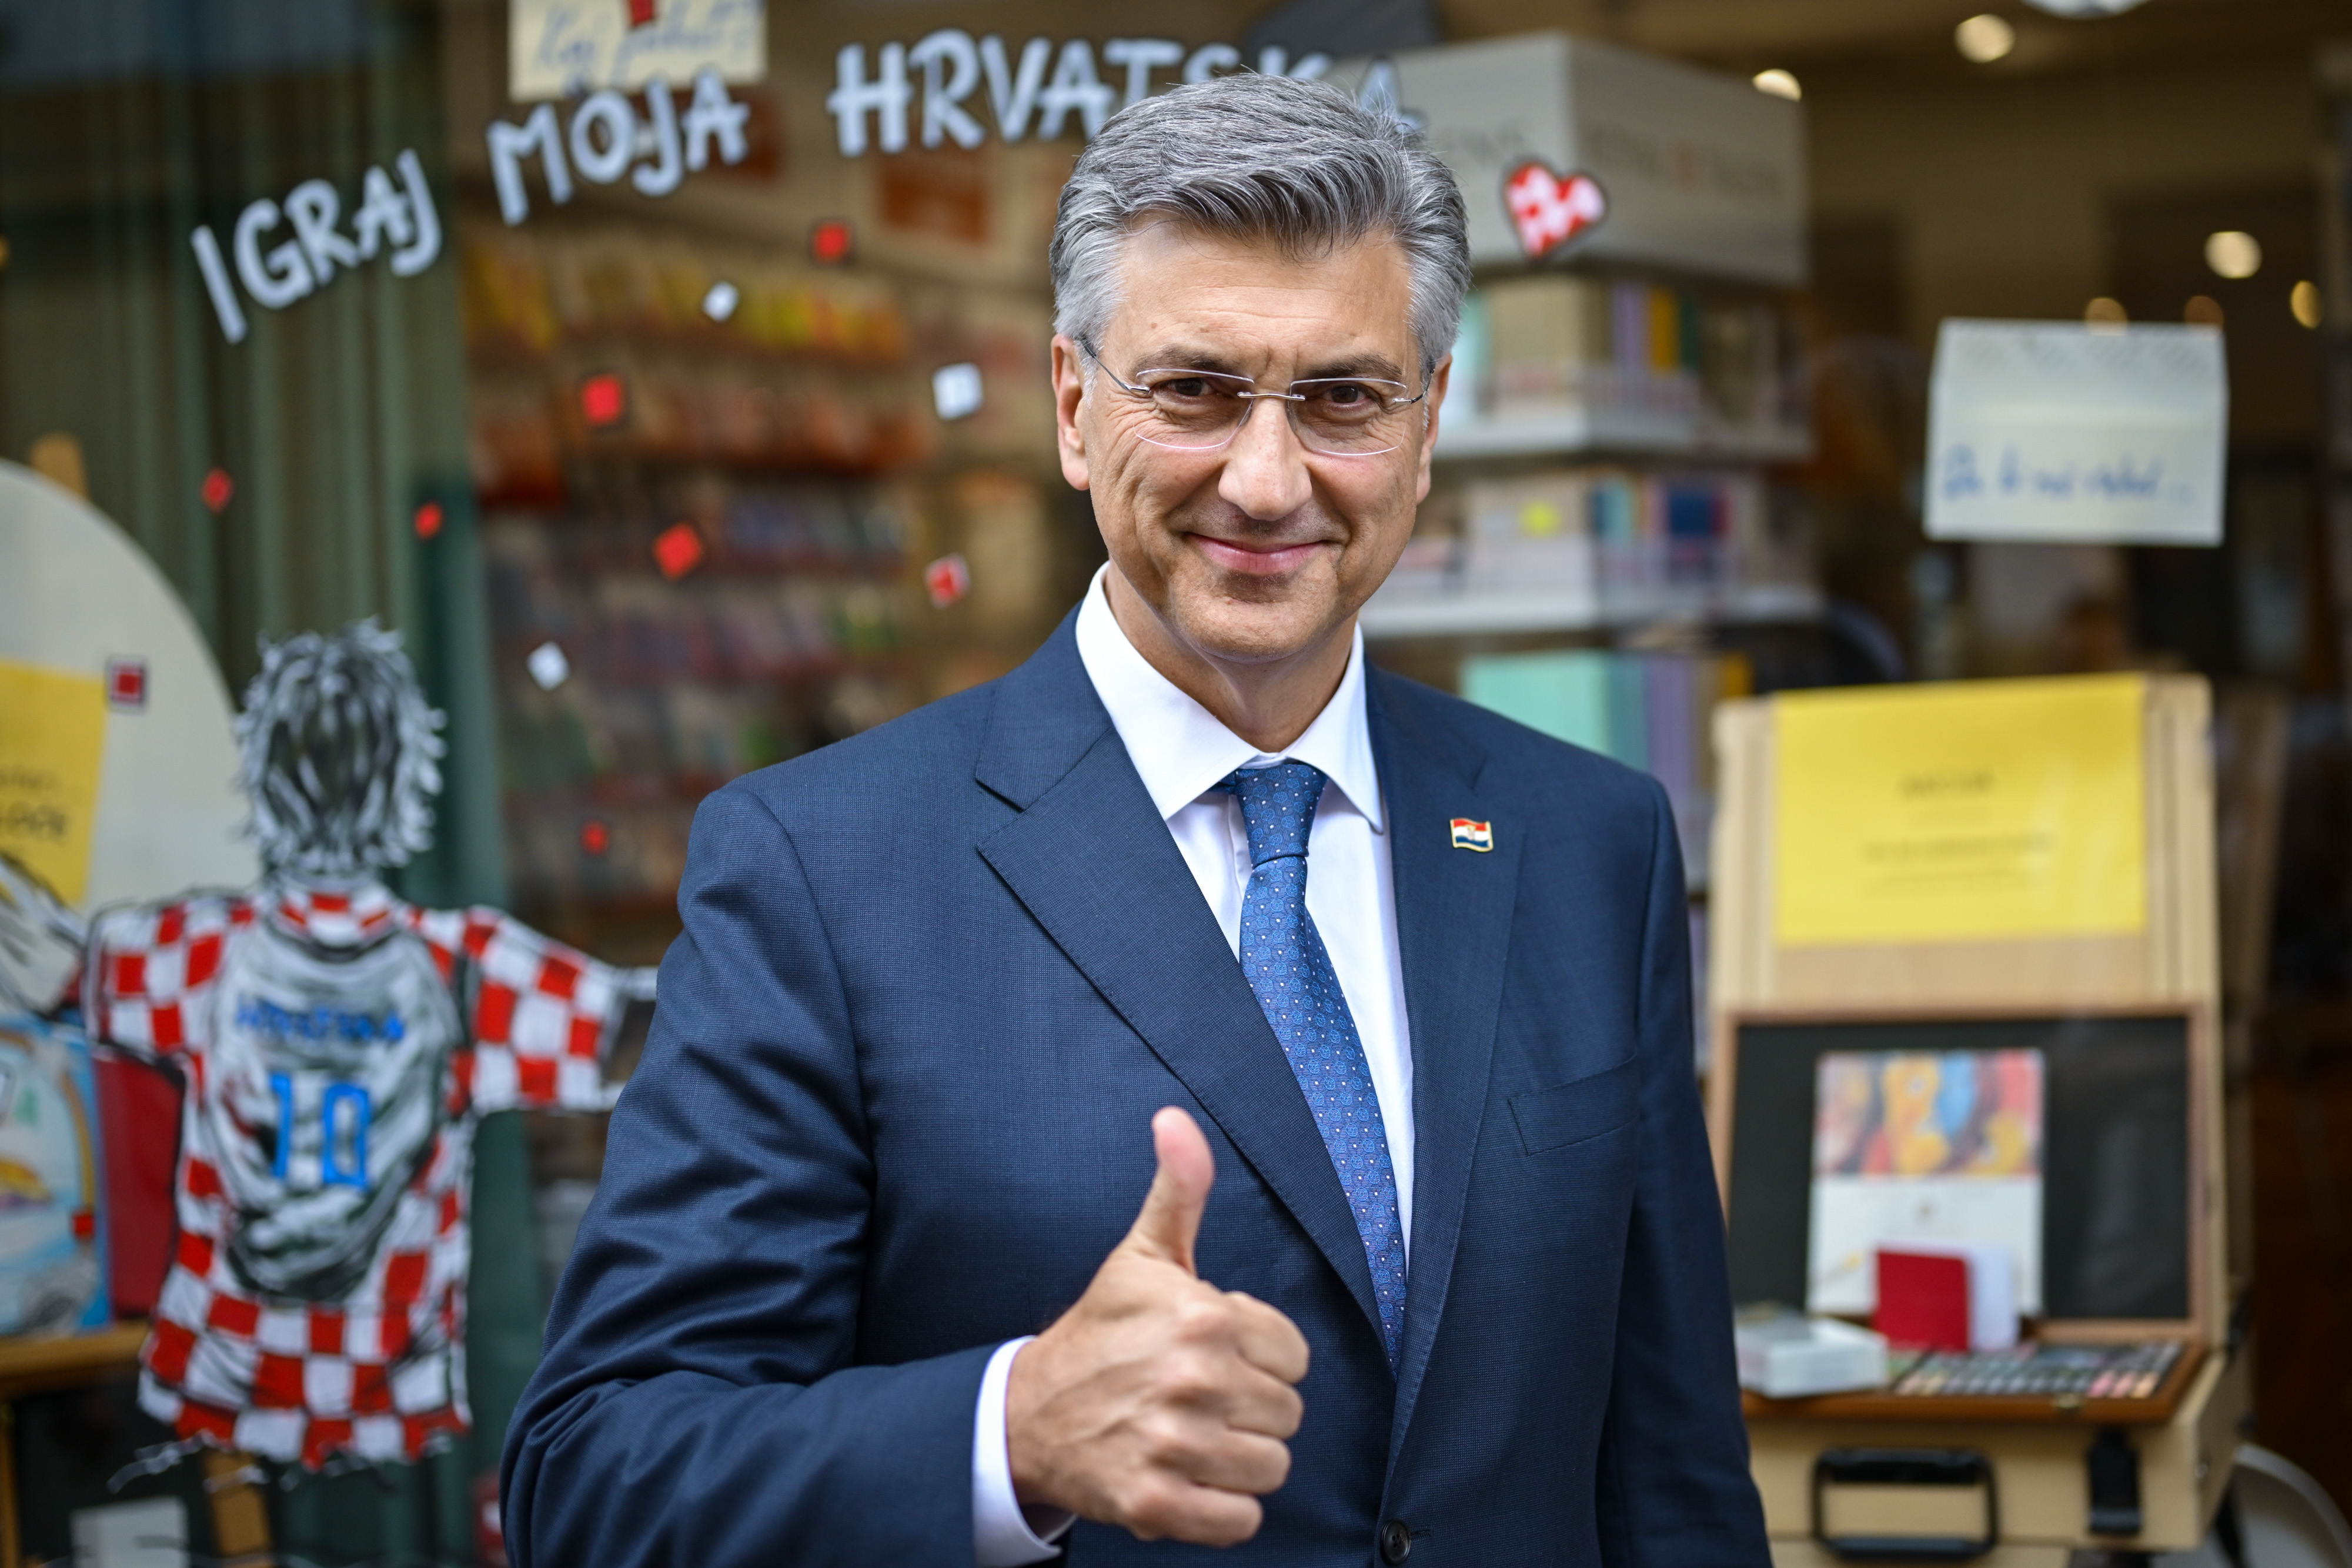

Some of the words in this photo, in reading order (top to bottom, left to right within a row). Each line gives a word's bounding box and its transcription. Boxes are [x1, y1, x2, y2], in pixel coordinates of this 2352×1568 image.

[191, 148, 442, 344] IGRAJ
[486, 66, 752, 226] MOJA
[269, 1071, 372, 1192] 10
